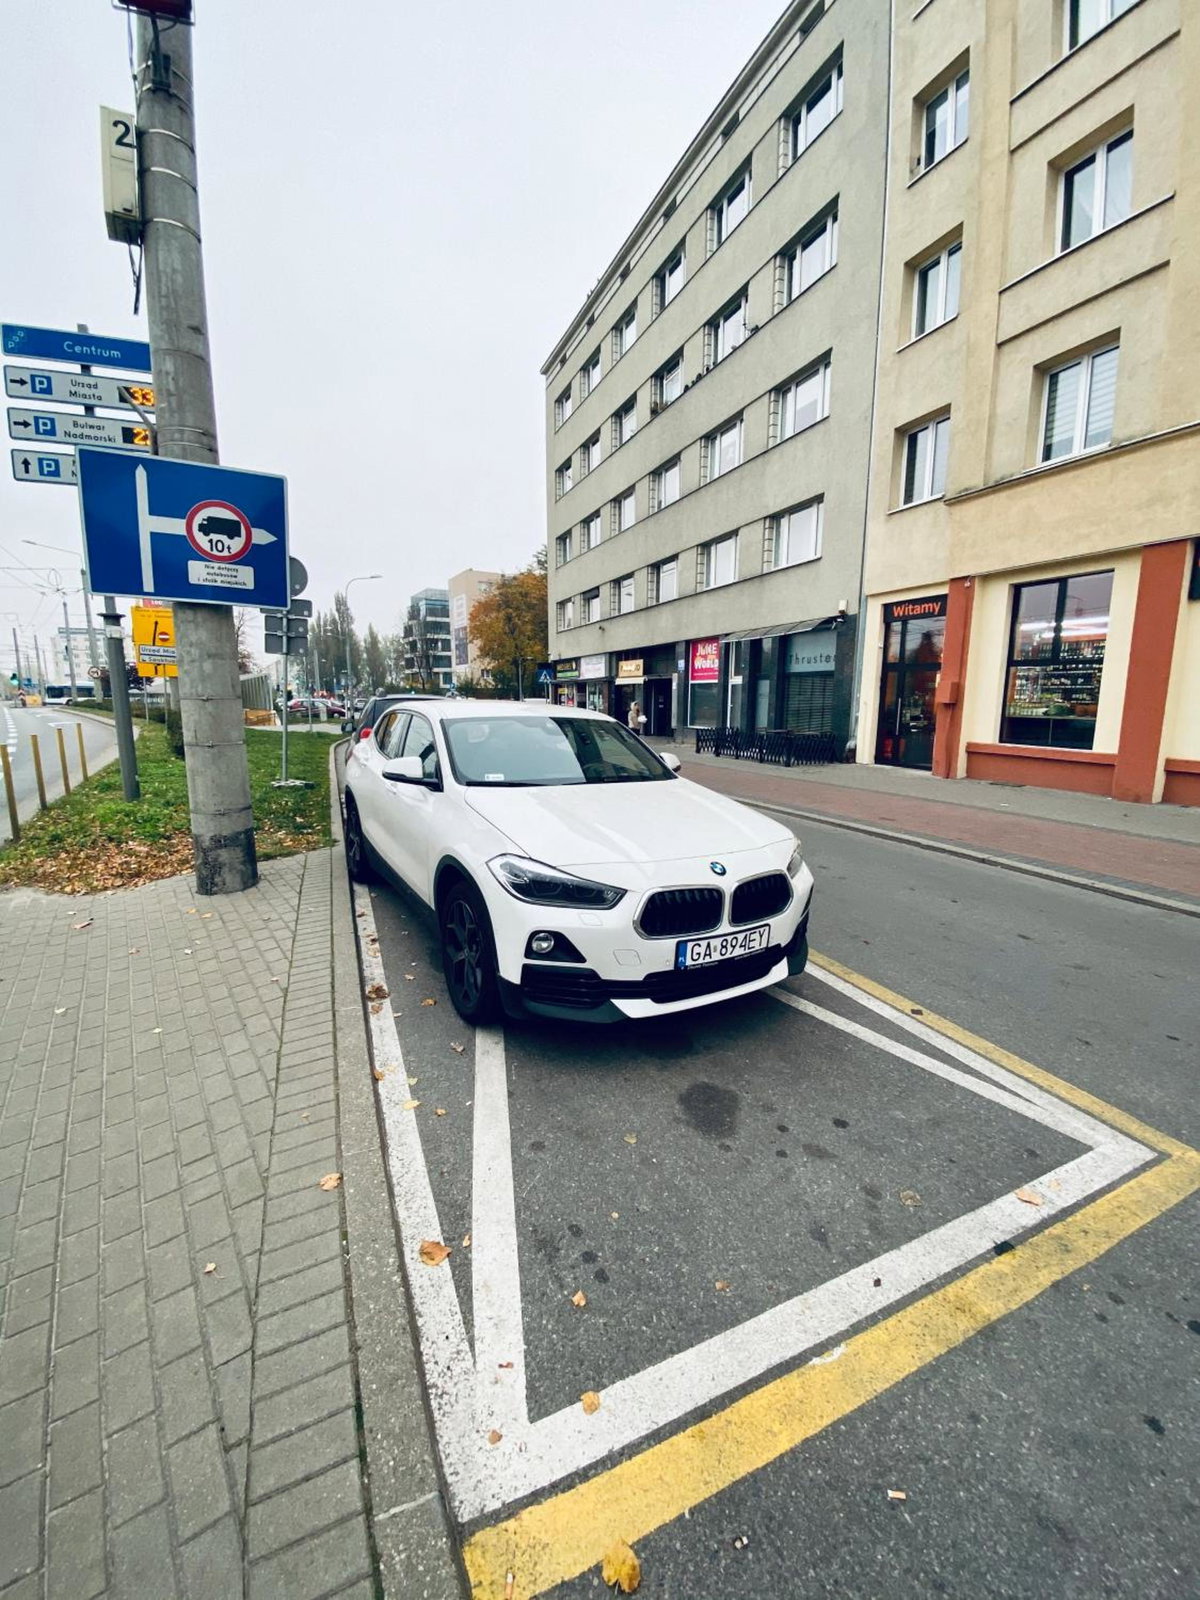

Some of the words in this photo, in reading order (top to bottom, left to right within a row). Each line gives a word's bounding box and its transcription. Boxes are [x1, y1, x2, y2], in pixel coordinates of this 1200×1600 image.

[112, 120, 136, 148] 2
[63, 341, 122, 358] Centrum
[35, 377, 48, 391] P
[69, 390, 103, 401] Miasta
[39, 418, 52, 433] P
[72, 420, 105, 431] Bulwar
[63, 430, 116, 443] Nadmorski
[42, 459, 56, 474] P
[893, 601, 941, 617] Witamy
[690, 941, 712, 962] GA
[719, 928, 766, 957] 894EY
